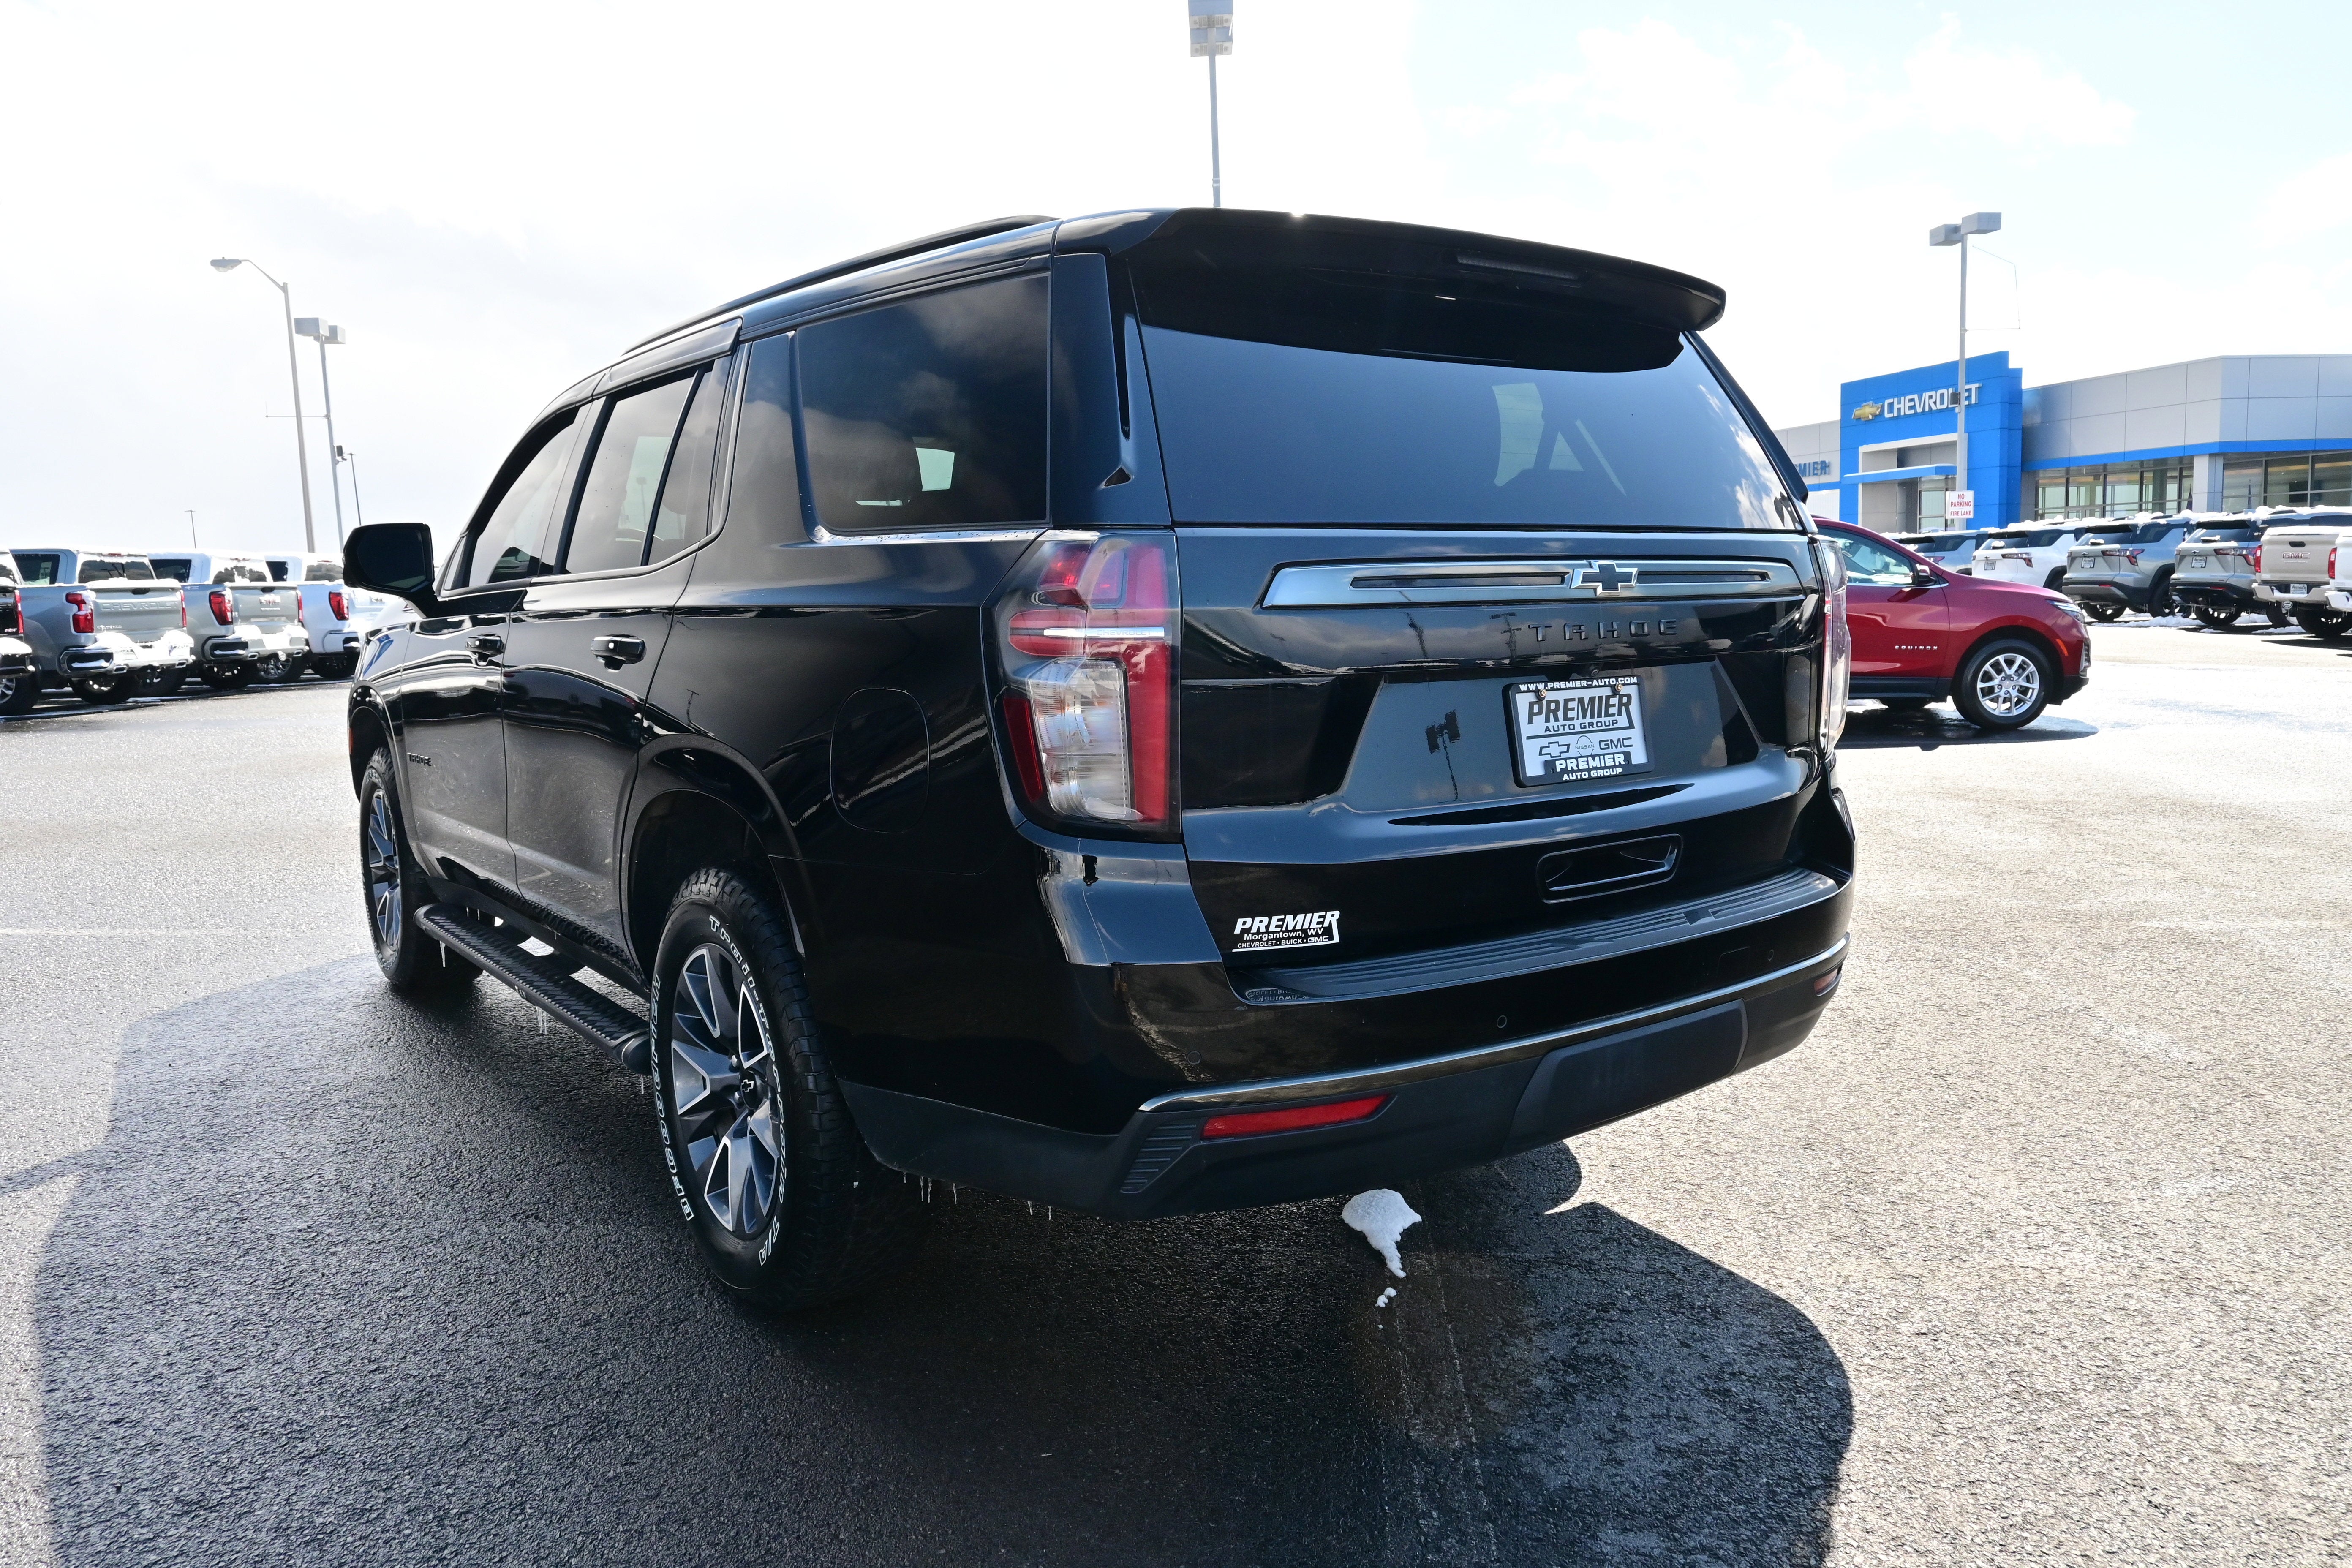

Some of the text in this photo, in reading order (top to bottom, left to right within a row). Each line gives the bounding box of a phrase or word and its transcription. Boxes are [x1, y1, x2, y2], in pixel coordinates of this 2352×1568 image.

[1794, 460, 1829, 477] MIER
[101, 601, 178, 611] CHEVROLET
[1527, 619, 1678, 642] TAHOE
[1519, 677, 1638, 691] WWW.PREMIER-AUTO.COM
[1527, 693, 1636, 728] PREMIER
[1544, 719, 1619, 733] AUTO GROUP
[1598, 737, 1633, 750] GMC
[1555, 753, 1625, 772] PREMIER
[1563, 767, 1622, 781] AUTO GROUP
[1233, 910, 1340, 942] PREMIER
[1237, 940, 1276, 948] CHEVROLET
[1307, 935, 1329, 943] GMC
[1244, 928, 1324, 941] Morgantown, WV
[649, 973, 694, 1222] BFGoodrich
